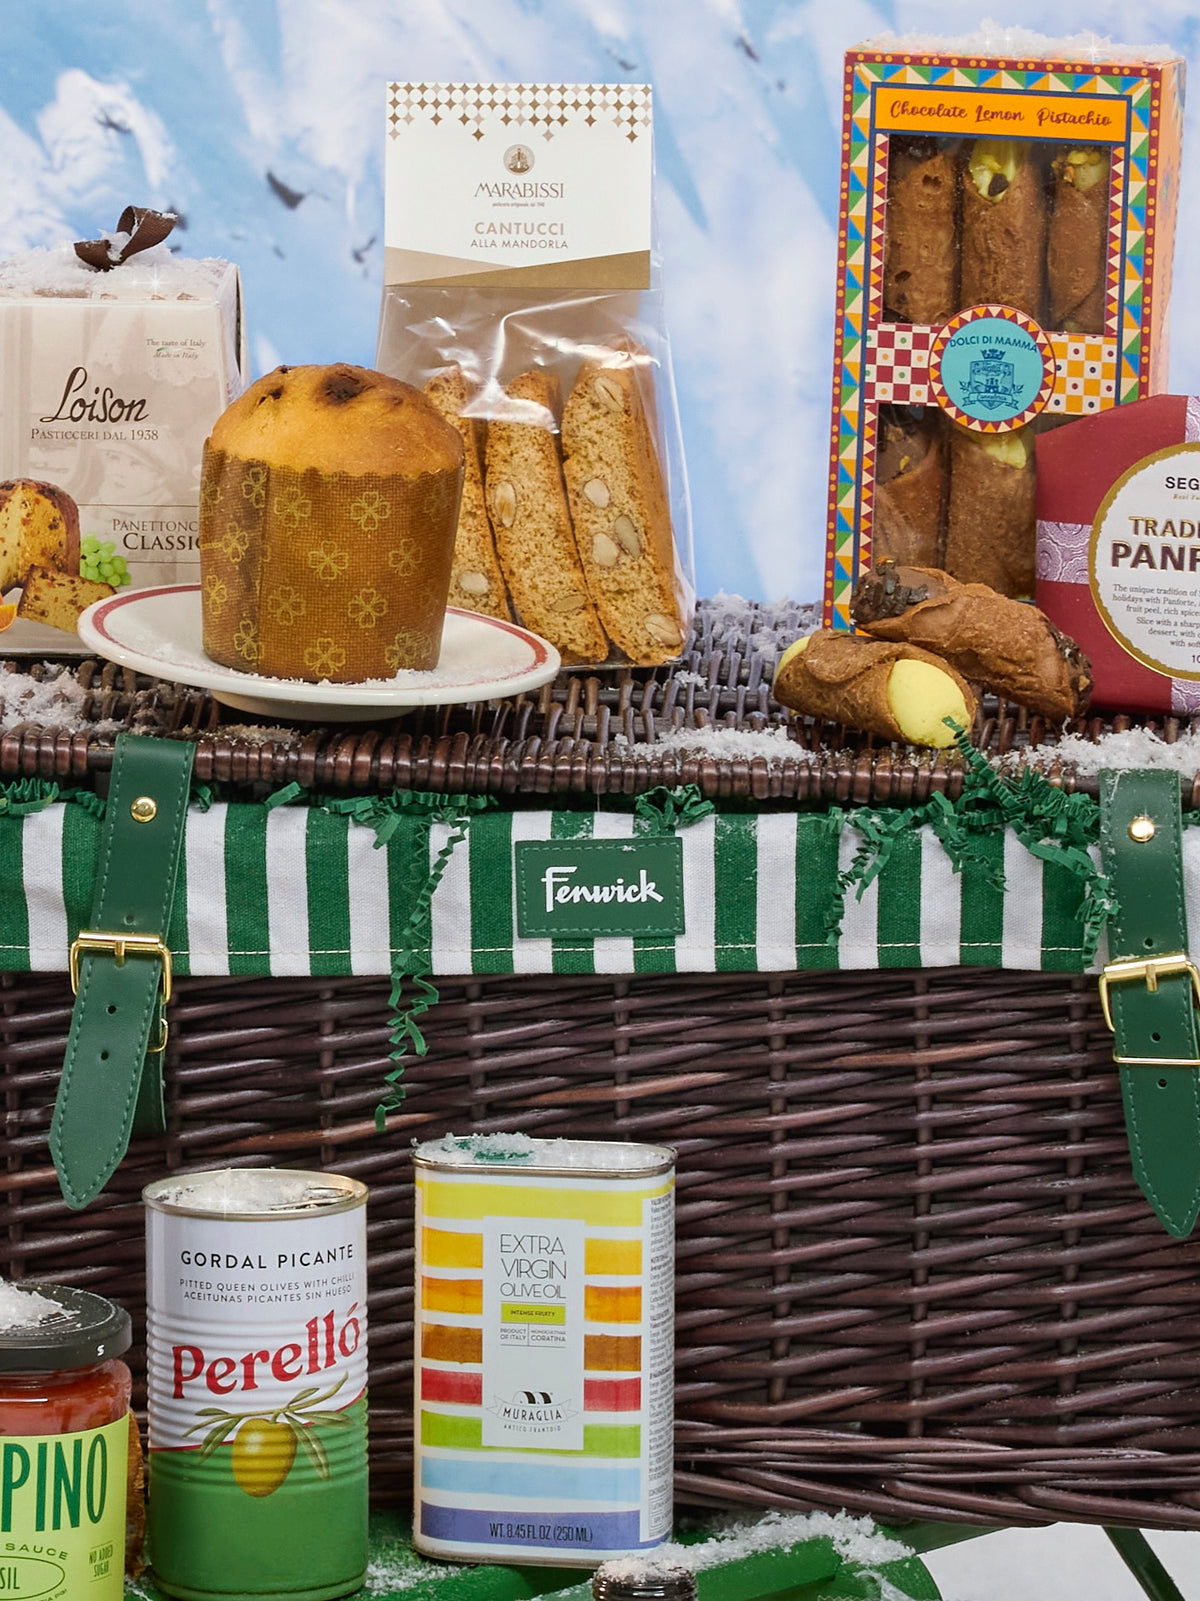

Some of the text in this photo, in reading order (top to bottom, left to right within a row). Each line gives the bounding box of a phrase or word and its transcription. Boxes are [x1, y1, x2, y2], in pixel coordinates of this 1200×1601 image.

[889, 100, 1112, 127] Chocolate Lemon Pistachio
[474, 182, 564, 200] MARABISSI
[474, 221, 564, 236] CANTUCCI
[470, 239, 569, 250] ALLA MANDORLA
[146, 338, 206, 349] The taste of Italy
[949, 335, 1038, 353] DOLCI DI MAMMA
[181, 352, 199, 360] Italy
[39, 366, 150, 423] Loison
[31, 428, 159, 441] PASTICCERI DAL 1938
[1165, 476, 1200, 491] SEG
[1112, 583, 1128, 592] The
[1129, 585, 1156, 595] unique
[1156, 587, 1188, 597] tradition
[1189, 589, 1198, 597] of
[1112, 593, 1197, 607] holidays with Panforte,
[1126, 604, 1143, 613] fruit
[1163, 607, 1179, 616] rich
[1136, 616, 1155, 625] Slice
[1156, 618, 1172, 627] with
[1148, 628, 1179, 637] dessert,
[1180, 630, 1196, 638] with
[541, 866, 664, 913] Fenwick
[500, 1233, 566, 1256] EXTRA
[180, 1244, 354, 1269] GORDAL PICANTE
[500, 1257, 567, 1280] VIRGIN
[179, 1271, 355, 1293] PITTED QUEEN OLIVES WITH CHILLI
[500, 1282, 567, 1299] OLIVE OIL
[184, 1284, 352, 1304] ACEITUNAS PICANTES SIN HUESO
[172, 1302, 361, 1399] Perelló
[503, 1406, 562, 1421] MURAGLIA
[503, 1424, 527, 1433] ANTICO
[1, 1433, 108, 1533] PINO
[489, 1522, 593, 1544] WT. 8.45 FL OZ (250 ML)
[5, 1542, 69, 1561] SAUCE
[88, 1549, 98, 1565] NO
